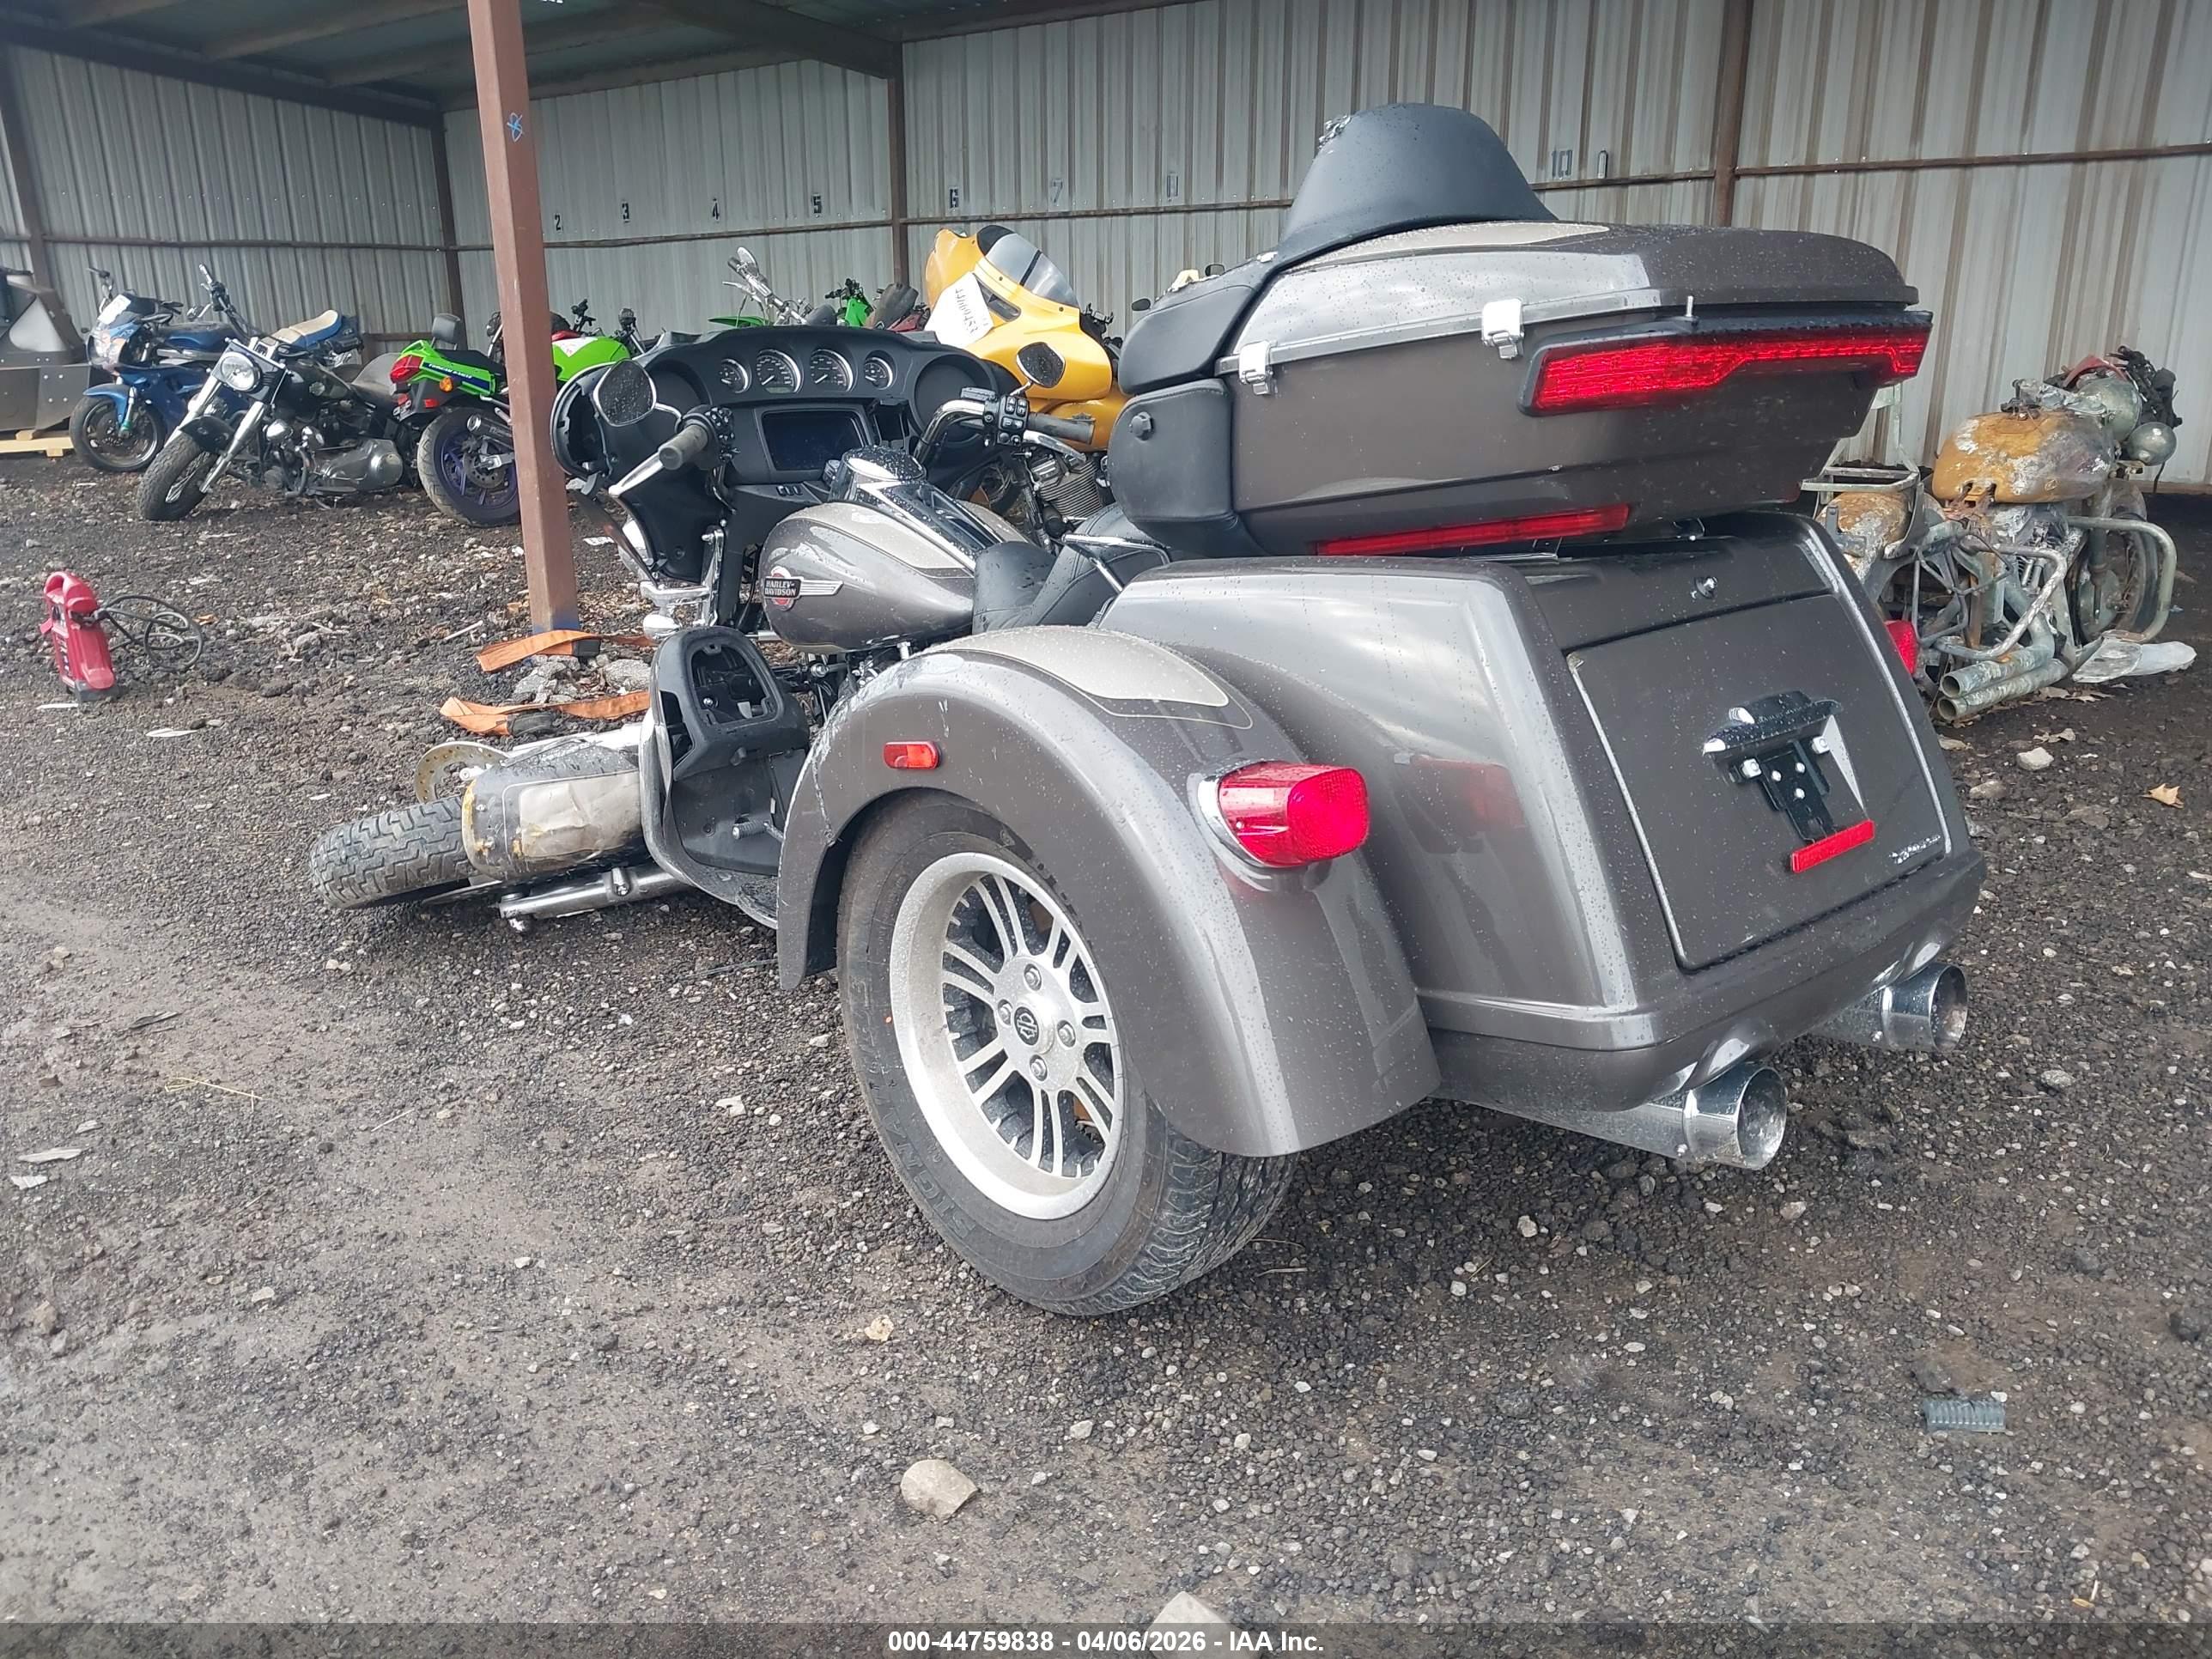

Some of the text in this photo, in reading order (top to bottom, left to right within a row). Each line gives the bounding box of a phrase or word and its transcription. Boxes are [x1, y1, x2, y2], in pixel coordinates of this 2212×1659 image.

[949, 187, 959, 209] 6
[1052, 179, 1064, 204] 7
[622, 203, 630, 221] 3
[712, 197, 720, 220] 4
[812, 195, 823, 214] 5
[554, 214, 562, 231] 2
[764, 587, 797, 597] DAVIDSON
